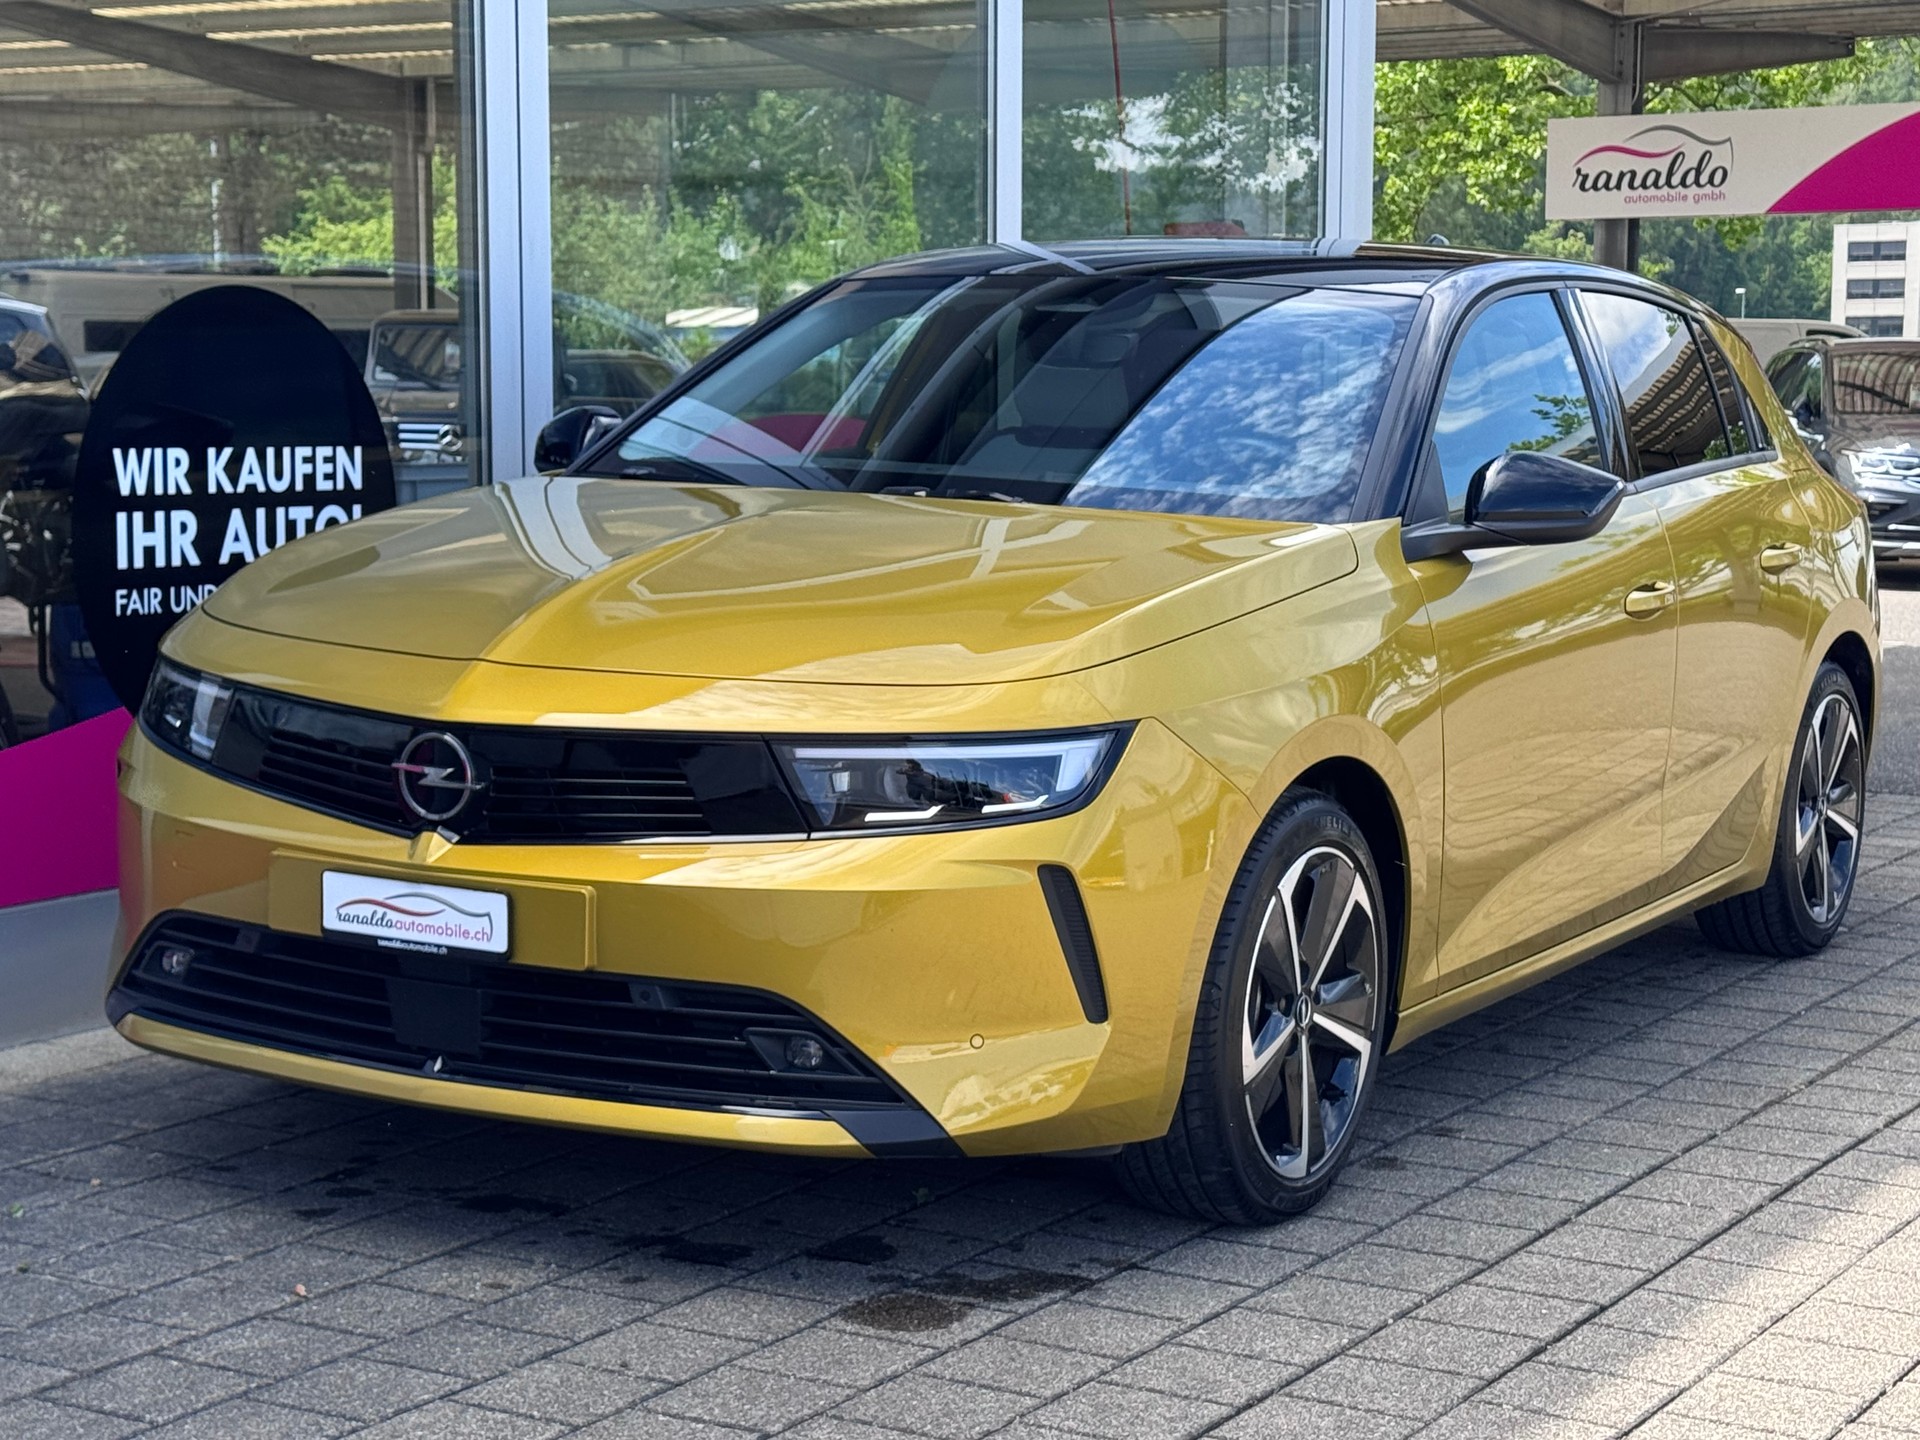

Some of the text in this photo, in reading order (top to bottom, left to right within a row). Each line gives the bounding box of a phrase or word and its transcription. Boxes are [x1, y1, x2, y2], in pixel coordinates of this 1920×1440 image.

[1572, 150, 1729, 192] ranaldo
[1624, 189, 1726, 204] automobile gmbh
[112, 445, 363, 496] WIR KAUFEN
[116, 503, 363, 570] IHR AUT
[115, 587, 163, 617] FAIR
[336, 907, 491, 942] ranaldoautomobile.ch
